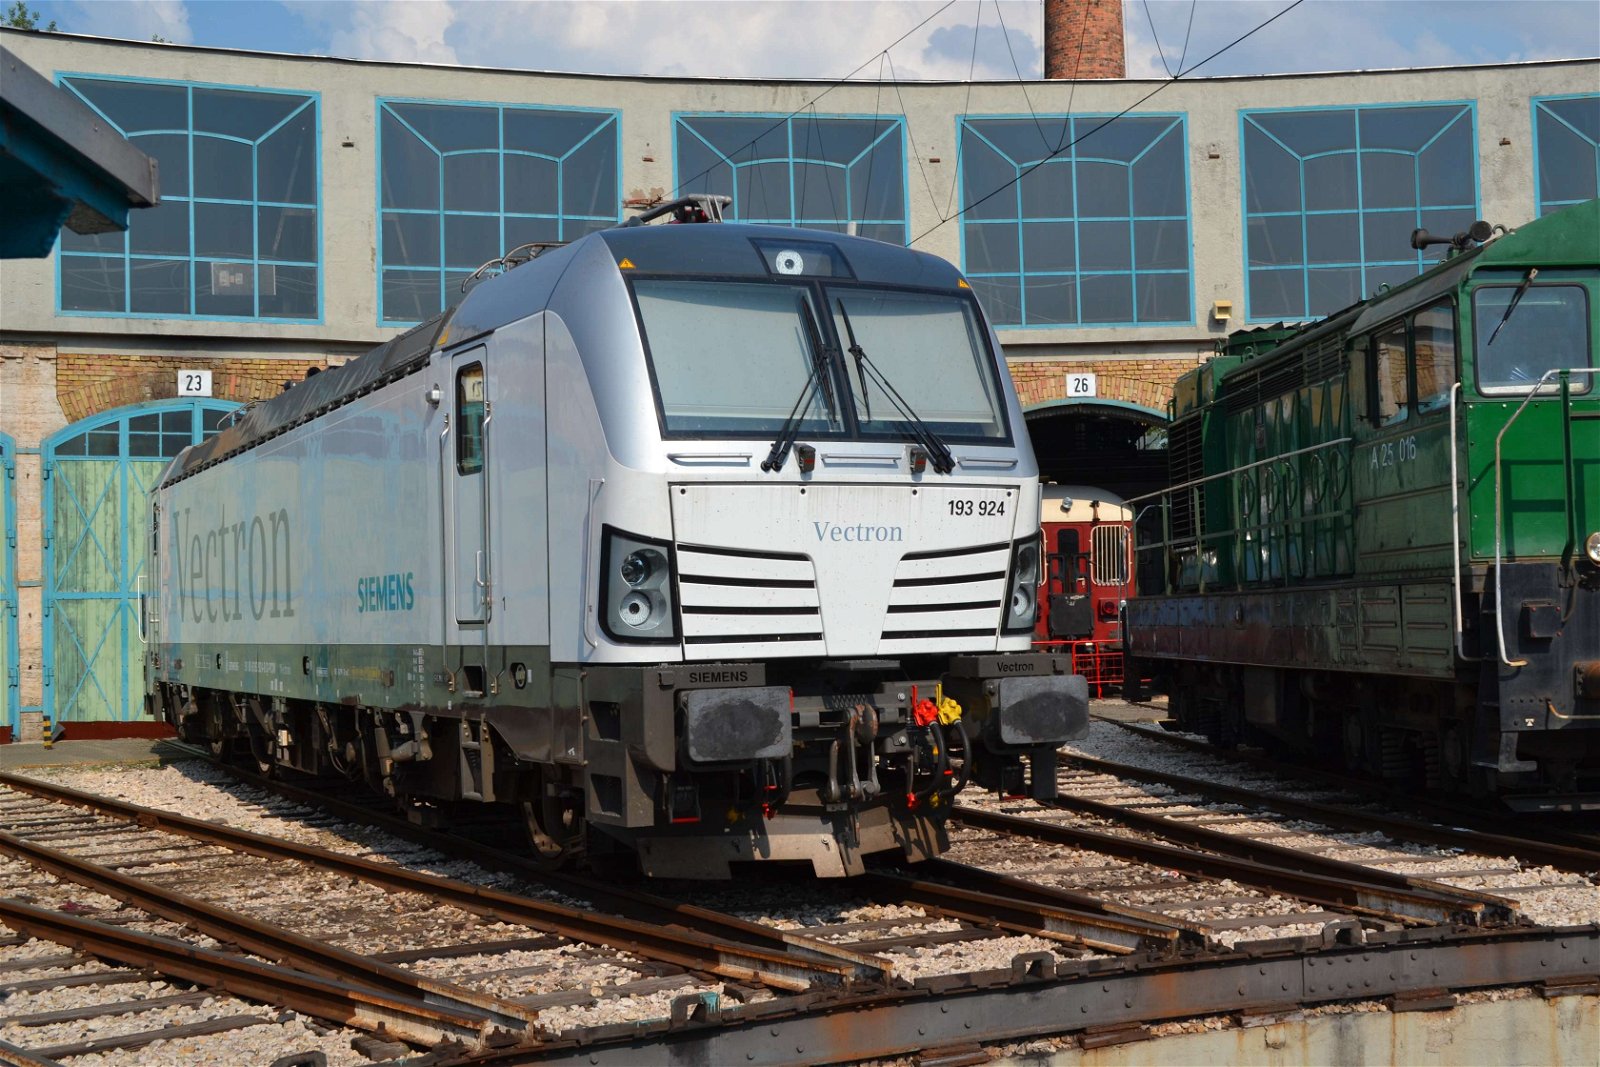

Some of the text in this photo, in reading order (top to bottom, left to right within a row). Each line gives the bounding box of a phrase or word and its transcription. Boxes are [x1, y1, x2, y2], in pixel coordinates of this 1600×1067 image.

[186, 374, 202, 391] 23
[1074, 377, 1089, 392] 26
[1371, 435, 1416, 469] A 25 016
[948, 500, 1005, 516] 193 924
[813, 521, 904, 542] Vectron
[173, 503, 295, 624] Vectron
[358, 572, 415, 613] SIEMENS
[997, 662, 1034, 672] Vectron
[689, 671, 748, 683] SIEMENS
